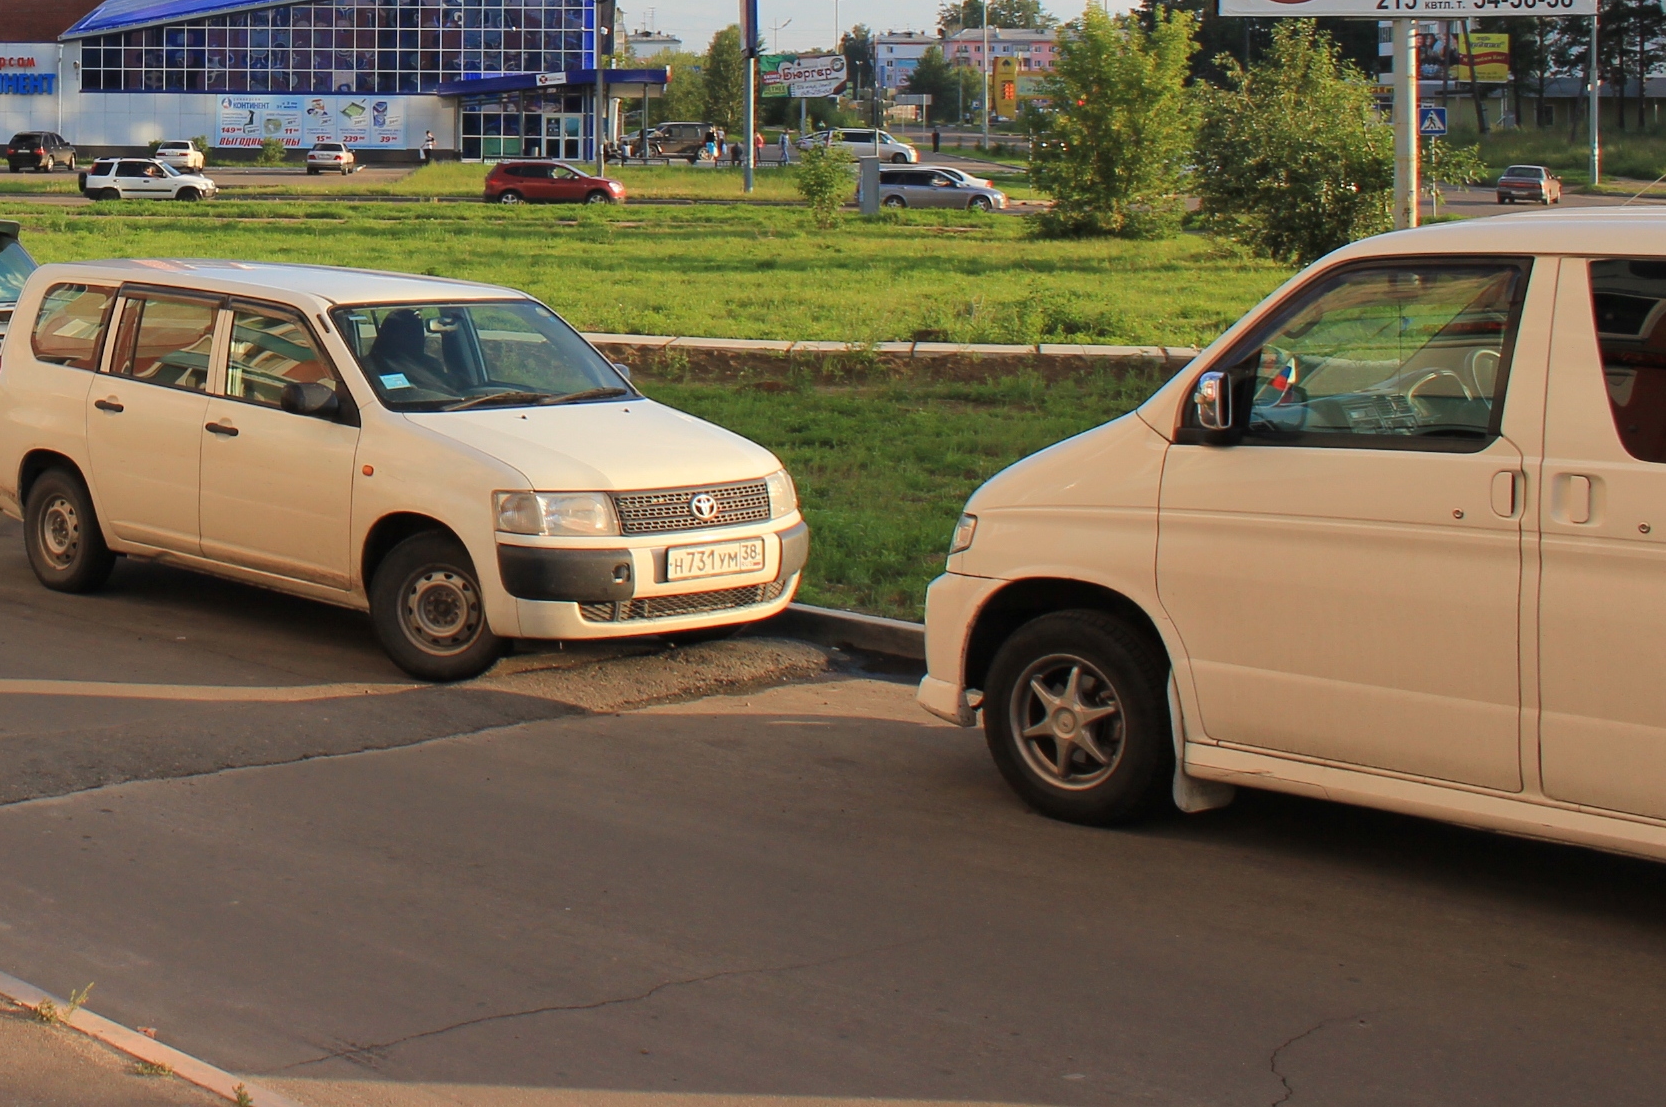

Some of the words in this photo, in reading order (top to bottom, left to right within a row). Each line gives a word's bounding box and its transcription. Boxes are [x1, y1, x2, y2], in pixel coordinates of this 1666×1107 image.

[219, 137, 267, 147] ВЫГОДНЫ
[674, 549, 738, 574] Н731УМ
[741, 543, 757, 560] 38
